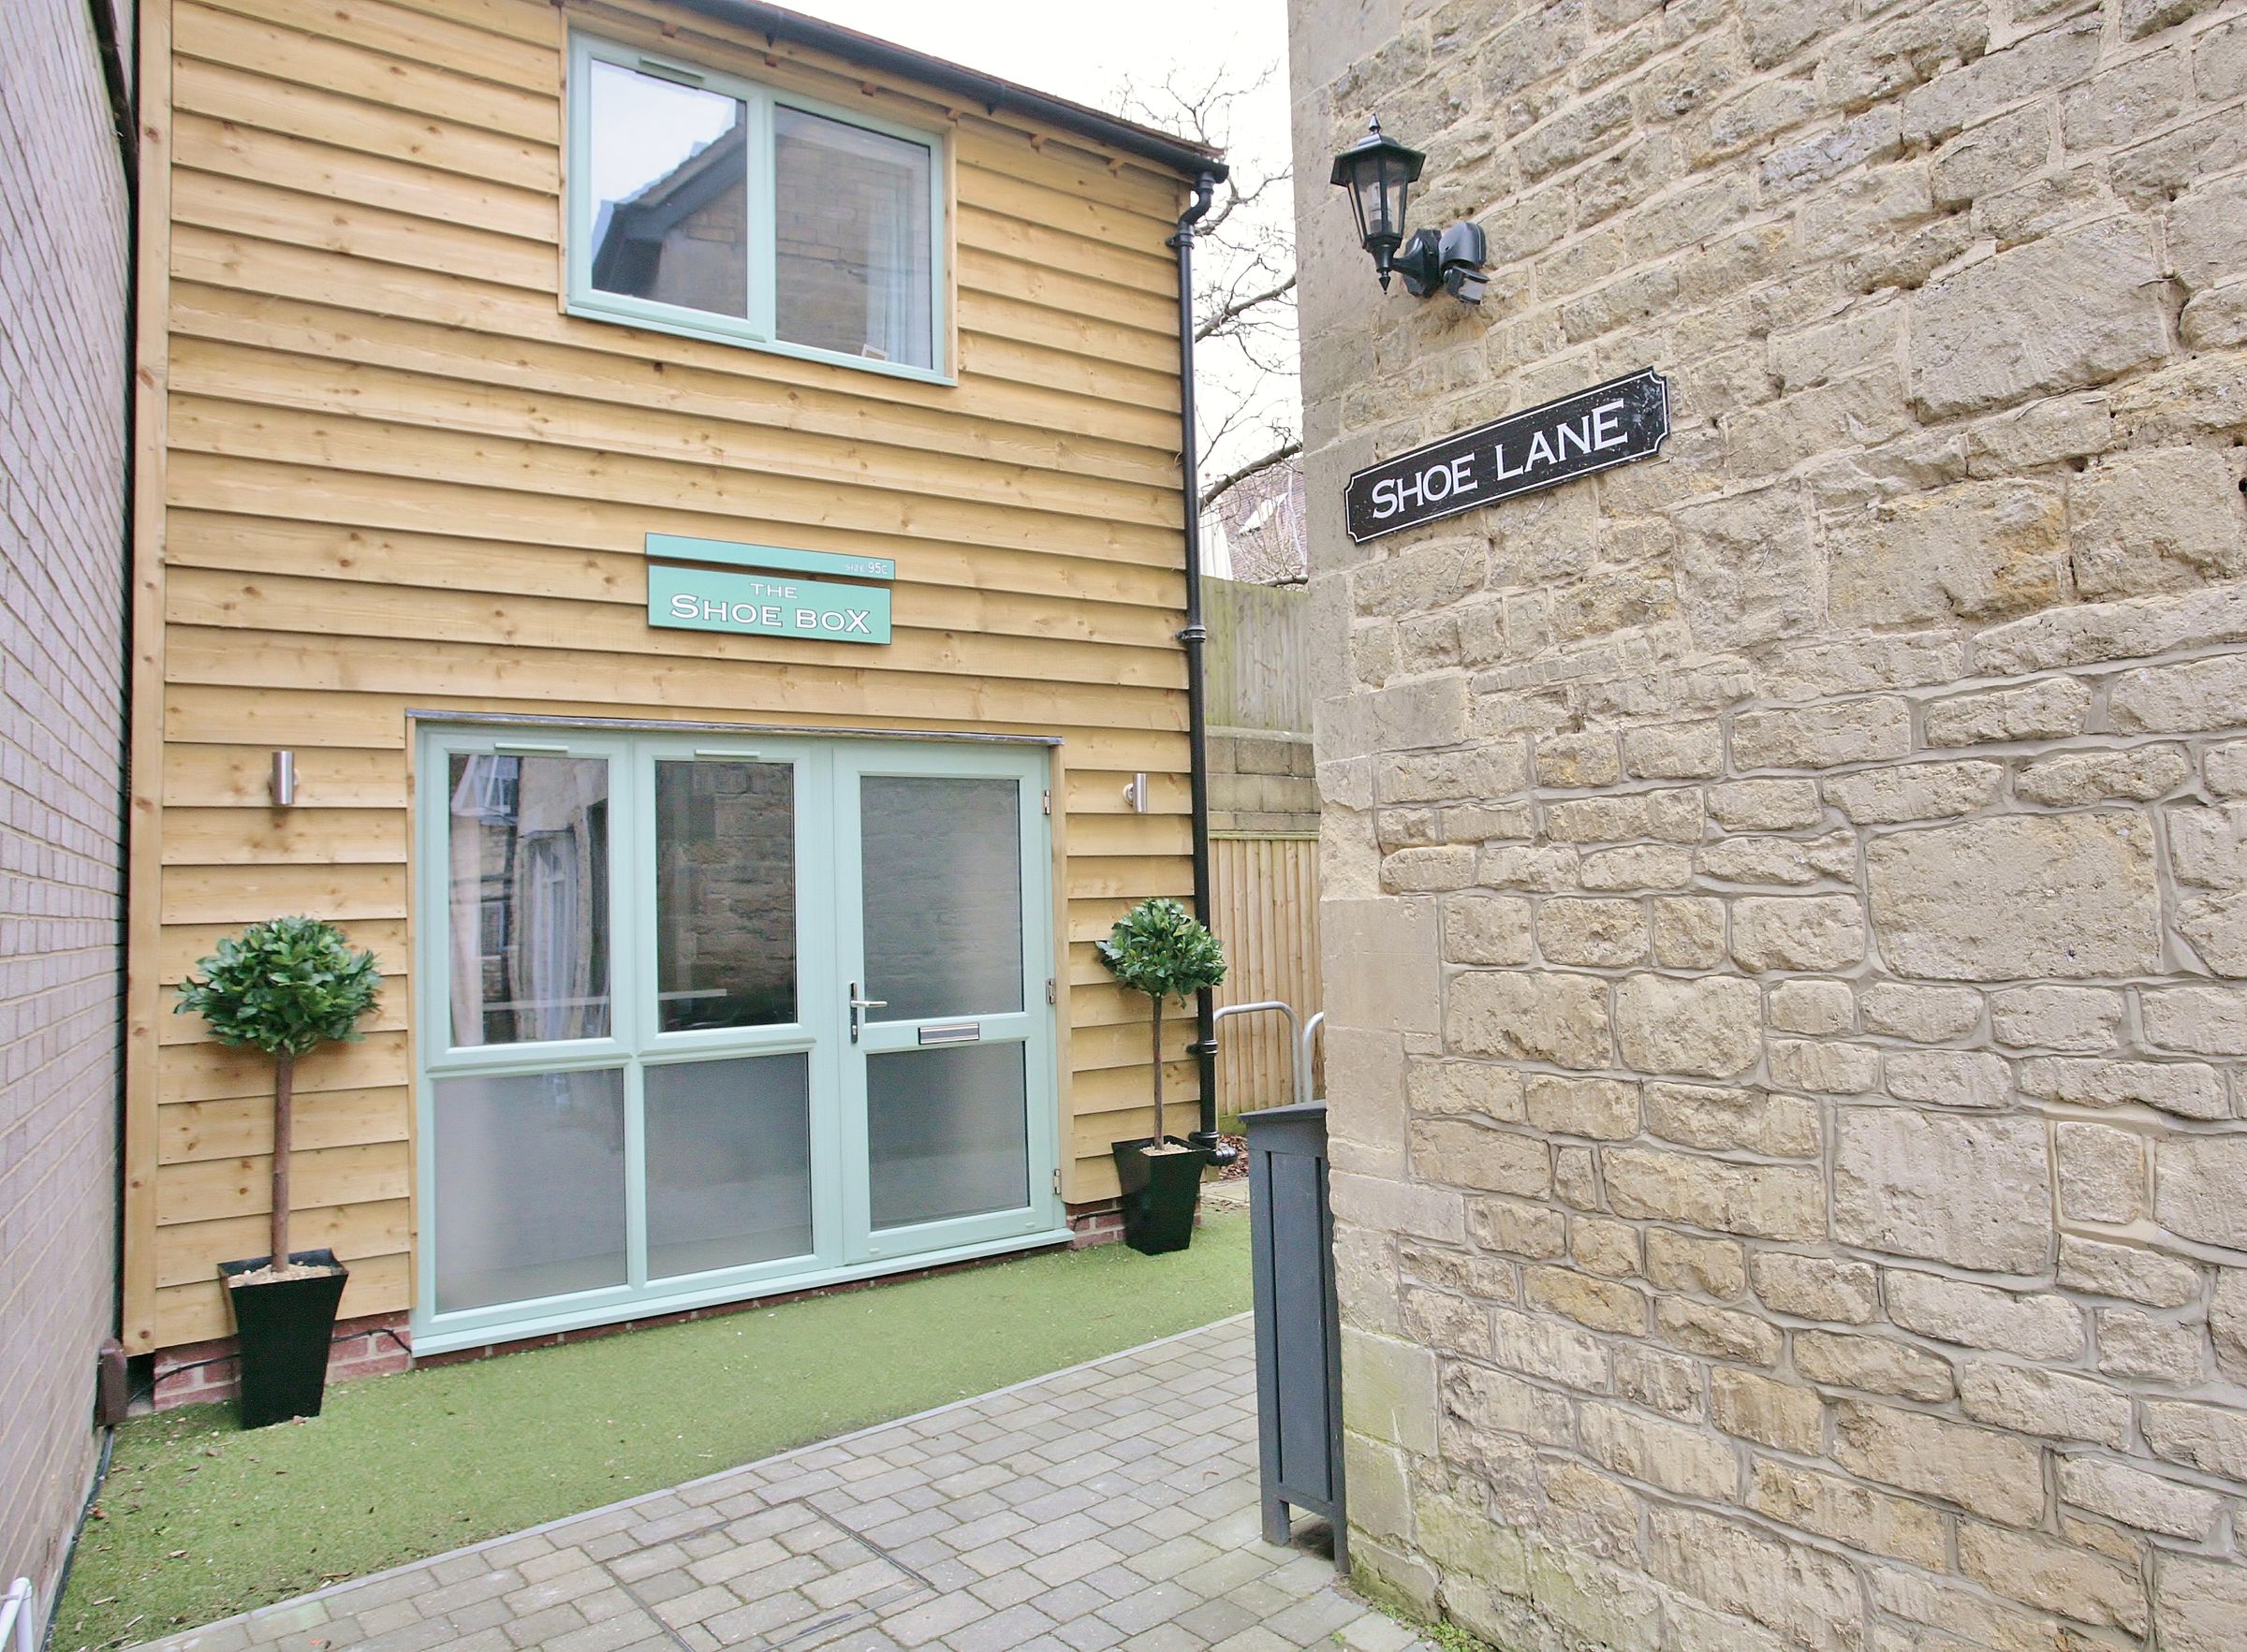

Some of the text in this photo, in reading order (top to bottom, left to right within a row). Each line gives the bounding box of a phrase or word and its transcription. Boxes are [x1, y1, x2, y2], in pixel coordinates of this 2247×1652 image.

[1372, 399, 1628, 519] SHOE LANE
[844, 563, 865, 573] SIZE
[750, 582, 799, 599] THE
[669, 593, 872, 635] SHOE BOX
